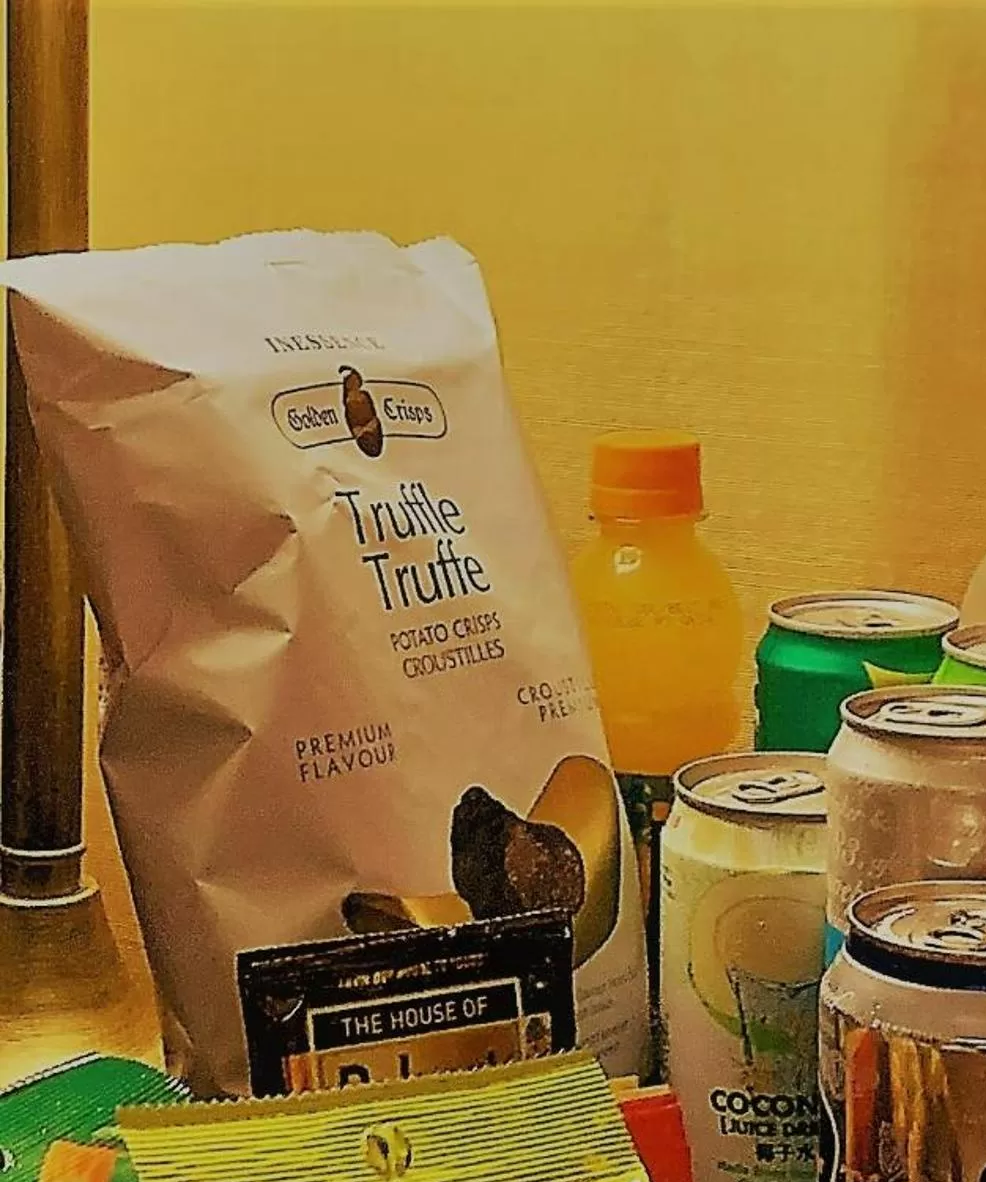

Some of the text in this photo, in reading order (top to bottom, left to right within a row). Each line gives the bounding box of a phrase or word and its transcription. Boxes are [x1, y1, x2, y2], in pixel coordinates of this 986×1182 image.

[287, 397, 433, 431] Golden Crisps
[335, 482, 466, 545] Truffle
[362, 540, 491, 611] Truffe
[390, 611, 501, 652] POTATO CRISPS
[402, 638, 505, 679] CROUSTILLES
[295, 721, 393, 759] PREMIUM
[299, 745, 399, 783] FLAVOUR
[341, 996, 489, 1038] THE HOUSE OF
